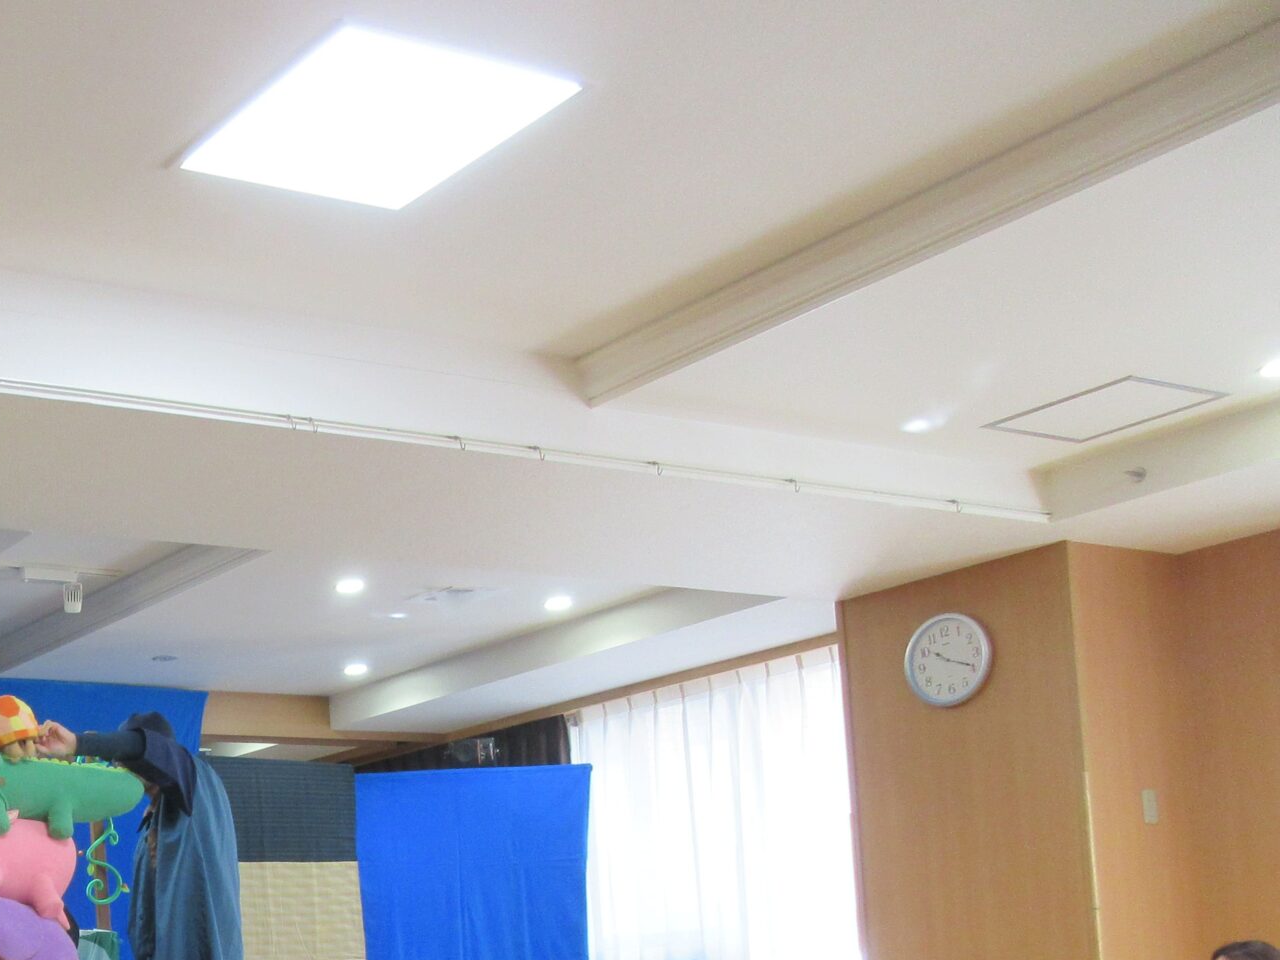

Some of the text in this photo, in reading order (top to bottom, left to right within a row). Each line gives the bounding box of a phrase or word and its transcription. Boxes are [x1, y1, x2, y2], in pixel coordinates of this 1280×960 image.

[940, 625, 950, 638] 12
[928, 633, 936, 645] 11
[966, 632, 973, 644] 2
[920, 646, 930, 658] 10
[972, 646, 979, 658] 3
[918, 663, 926, 674] 9
[925, 676, 932, 687] 8
[962, 676, 969, 688] 5
[935, 683, 943, 695] 7
[948, 683, 957, 694] 6
